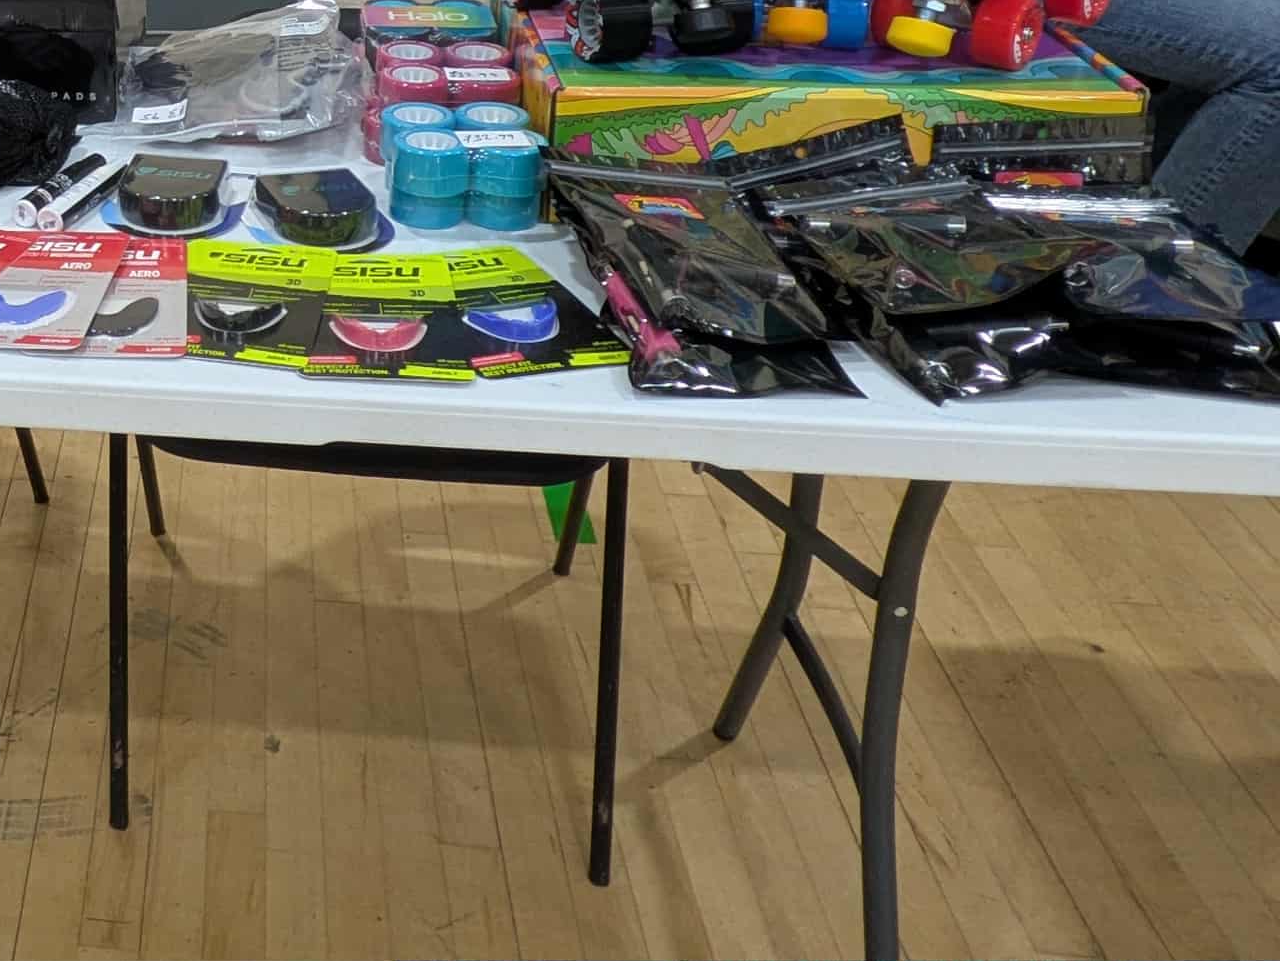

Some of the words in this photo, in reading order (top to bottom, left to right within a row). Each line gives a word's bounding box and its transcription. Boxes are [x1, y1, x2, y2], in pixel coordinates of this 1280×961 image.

[387, 11, 469, 22] Halo
[50, 91, 98, 102] PADS
[221, 252, 308, 268] SISU
[59, 261, 94, 271] AERO
[128, 270, 161, 278] AERO
[333, 266, 421, 278] SISU
[285, 278, 302, 286] 3D
[409, 289, 426, 297] 3D
